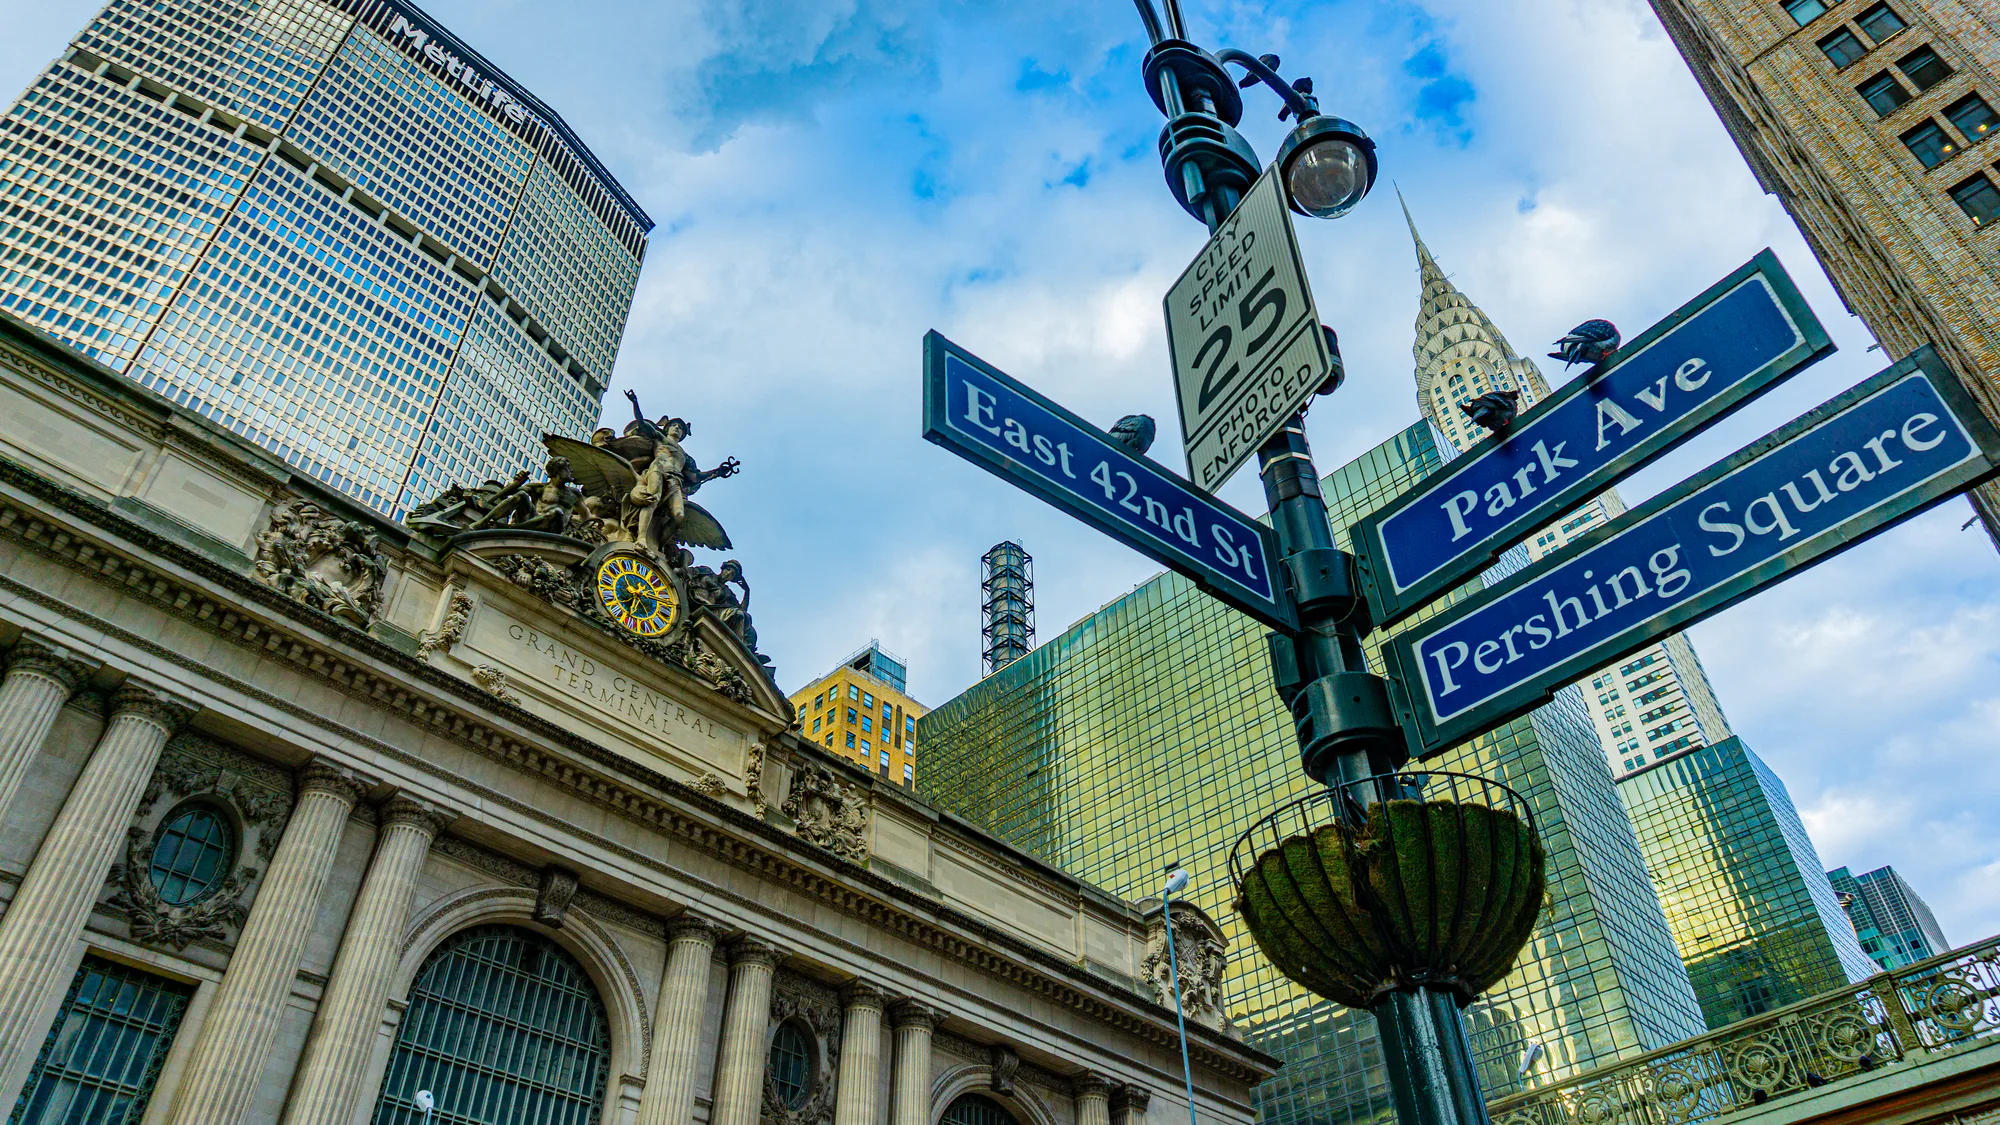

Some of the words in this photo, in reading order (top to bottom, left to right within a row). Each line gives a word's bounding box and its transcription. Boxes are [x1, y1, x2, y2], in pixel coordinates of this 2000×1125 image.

[391, 15, 525, 124] MetLife
[1190, 231, 1255, 316] SPEED
[1196, 218, 1240, 281] CITY
[1200, 258, 1252, 332] LIMIT
[1191, 265, 1286, 415] 25
[1202, 364, 1311, 485] ENFORCED
[1218, 366, 1284, 445] PHOTO
[1440, 439, 1579, 543] Park
[1595, 357, 1713, 452] Ave
[962, 379, 1077, 479] East
[1090, 461, 1201, 548] 42nd
[1211, 523, 1258, 580] St
[1429, 543, 1692, 698] Pershing
[1698, 412, 1947, 557] Square
[508, 624, 595, 676] GRAND
[613, 677, 716, 739] CENTRAL
[554, 664, 671, 735] TERMINAL
